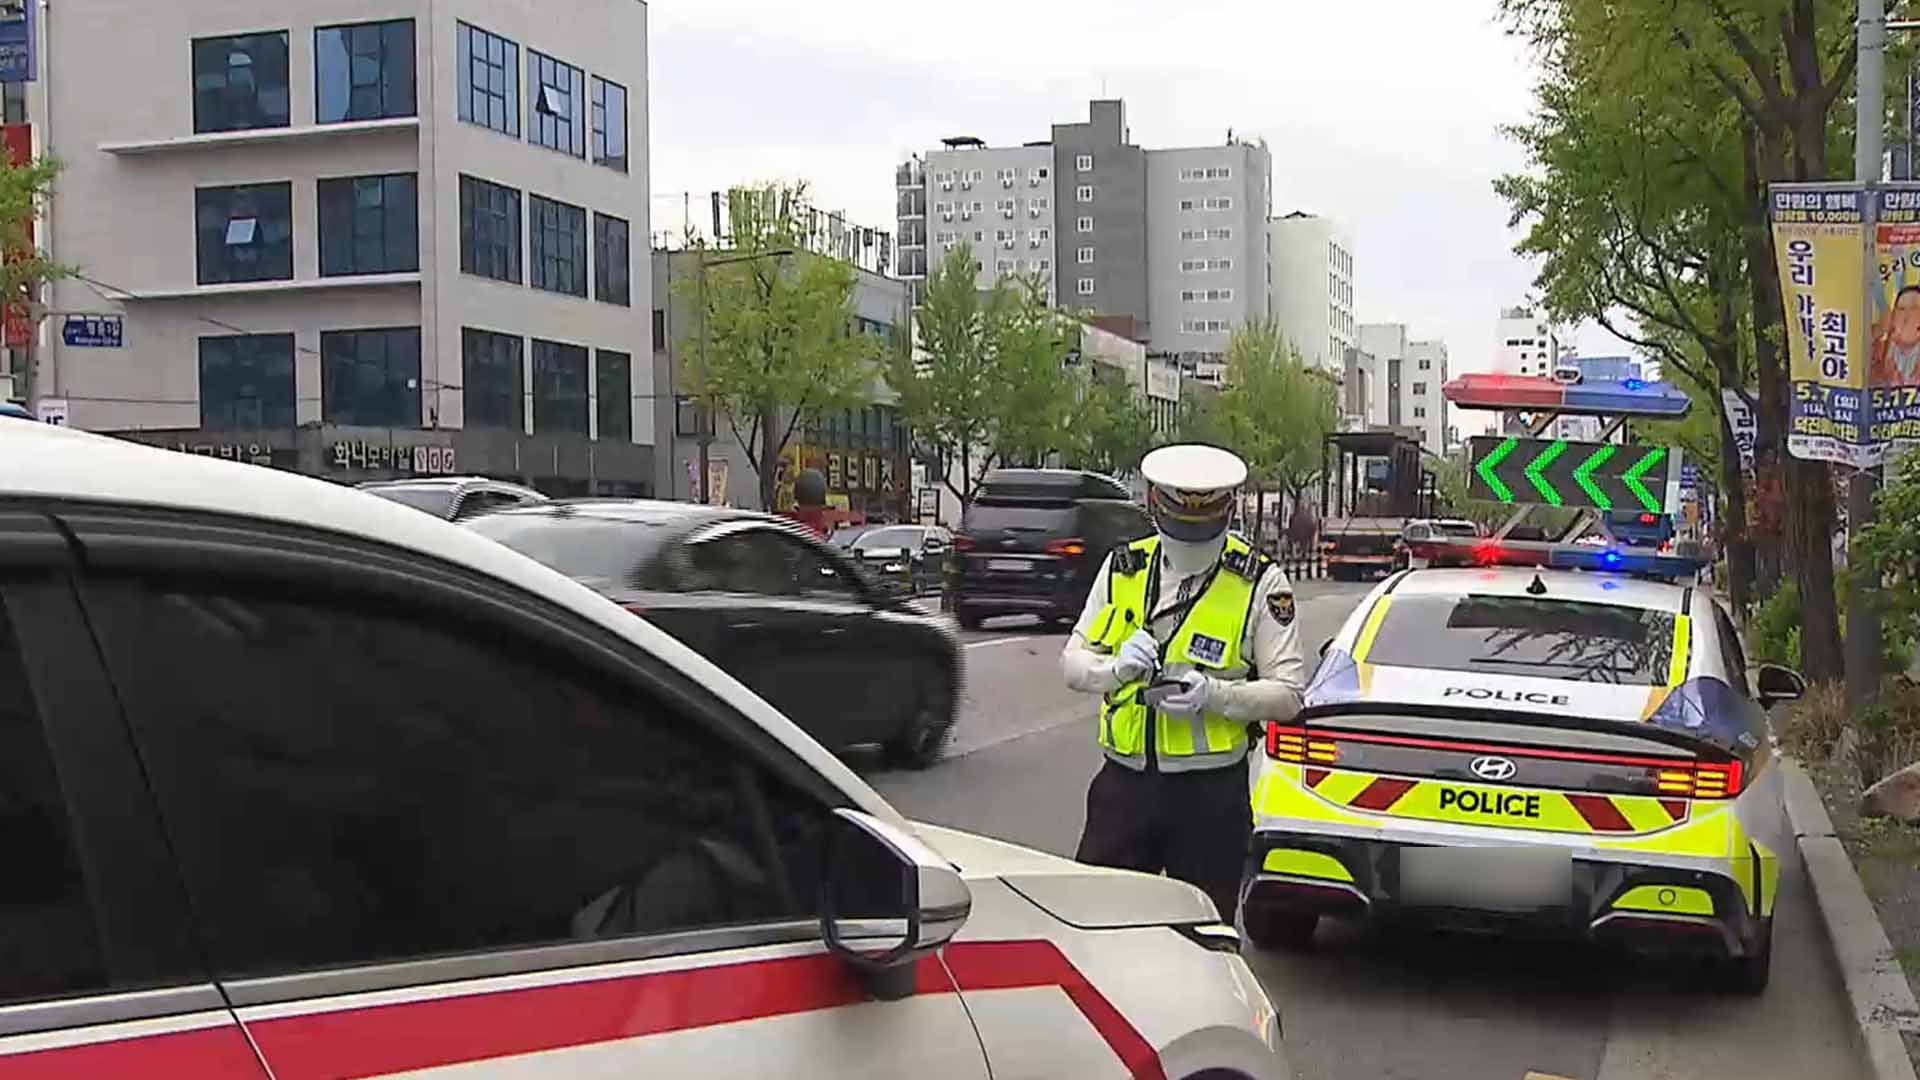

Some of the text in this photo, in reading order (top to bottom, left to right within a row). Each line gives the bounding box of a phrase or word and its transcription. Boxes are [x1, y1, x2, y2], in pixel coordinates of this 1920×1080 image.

[1788, 240, 1814, 285] 우리
[1821, 312, 1849, 379] 최고야
[1443, 687, 1570, 706] POLICE
[1439, 788, 1540, 818] POLICE
